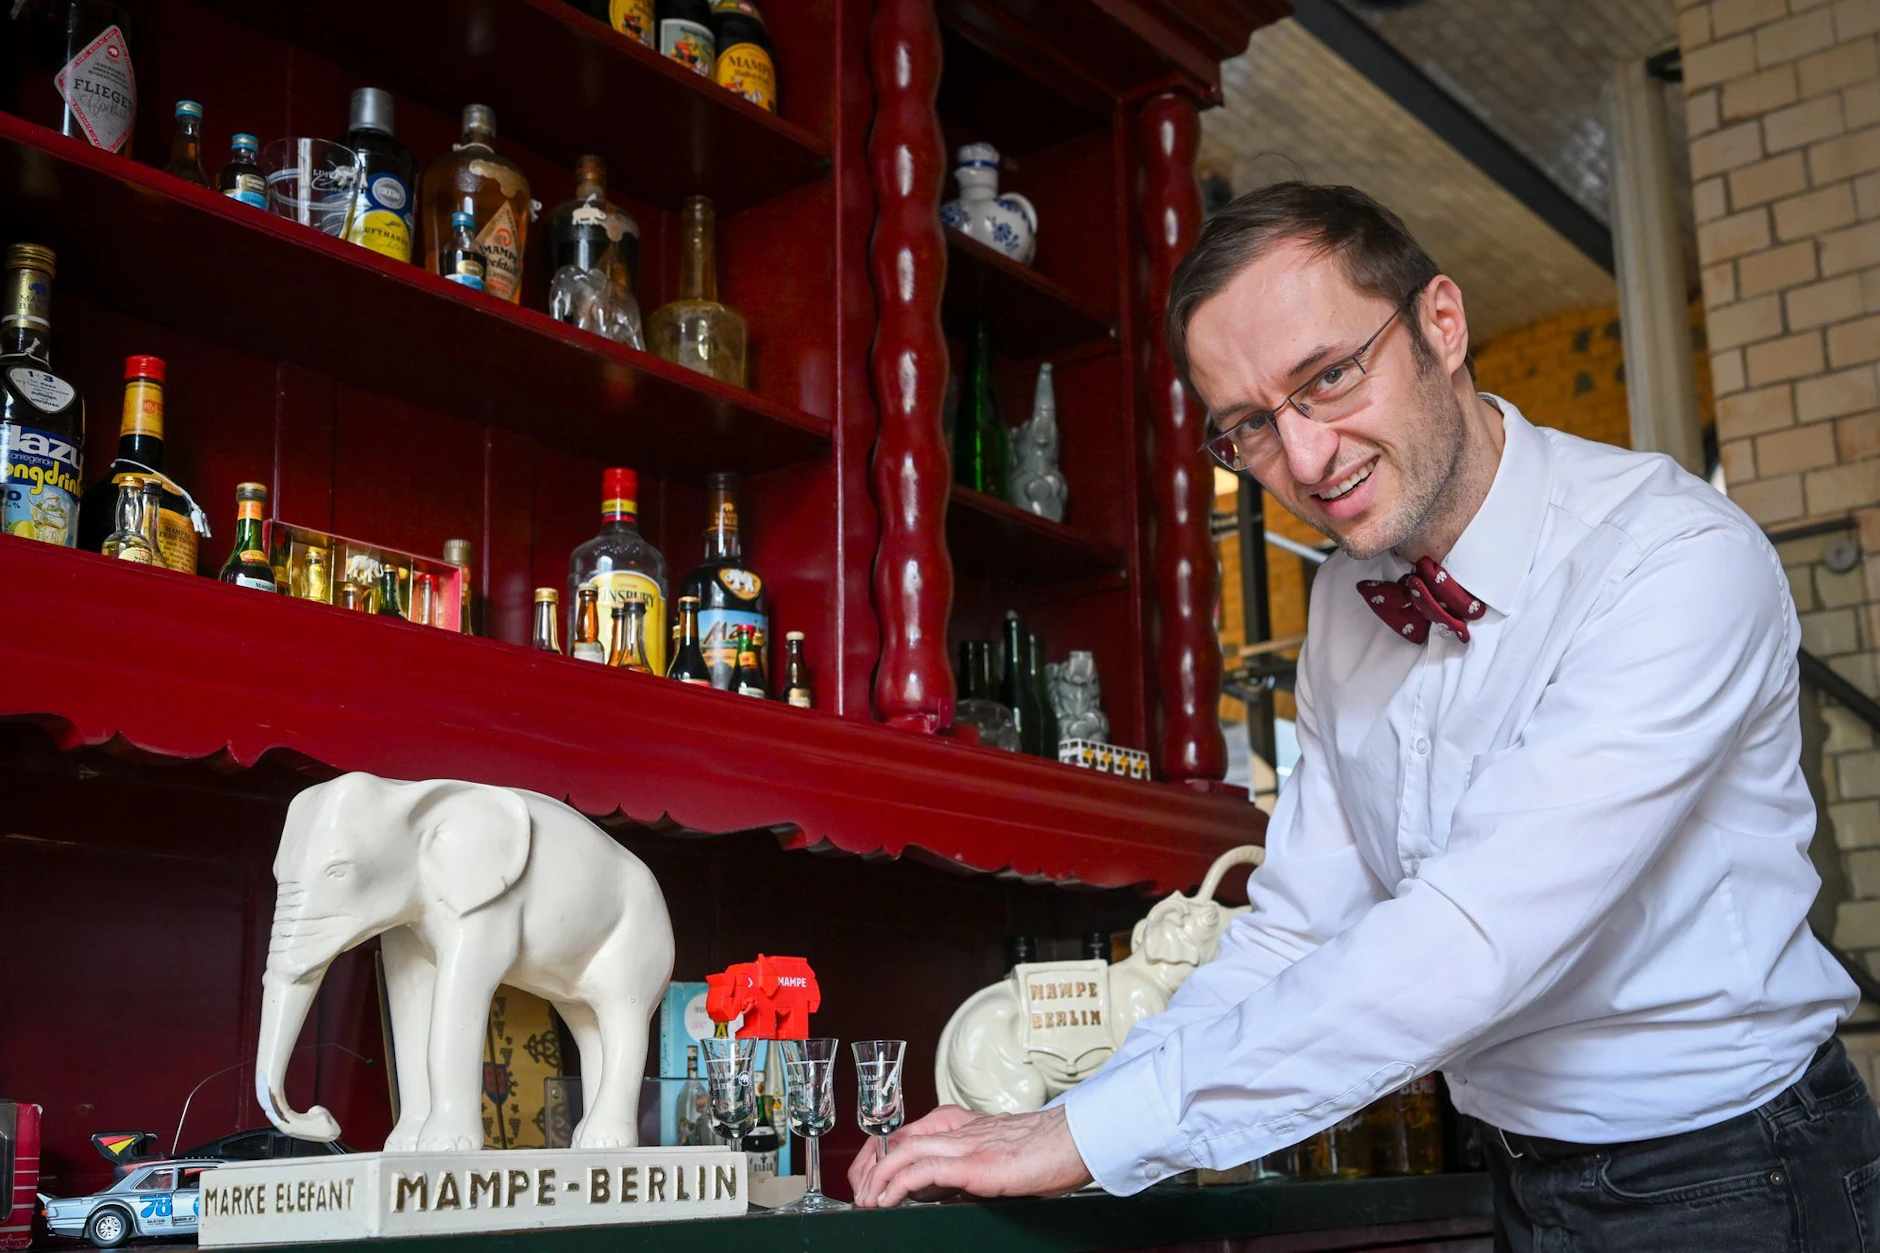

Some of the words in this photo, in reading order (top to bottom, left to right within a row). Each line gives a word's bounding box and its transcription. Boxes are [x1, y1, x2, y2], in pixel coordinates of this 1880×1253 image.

[600, 587, 655, 609] INSBURY
[777, 976, 807, 988] MAMPE
[1029, 981, 1098, 1002] MAMPE
[1031, 1009, 1102, 1030] BERLIN
[204, 1182, 267, 1218] MARKE
[276, 1176, 356, 1214] ELEFANT
[392, 1164, 738, 1213] MAMPE-BERLIN
[139, 1193, 173, 1219] 78
